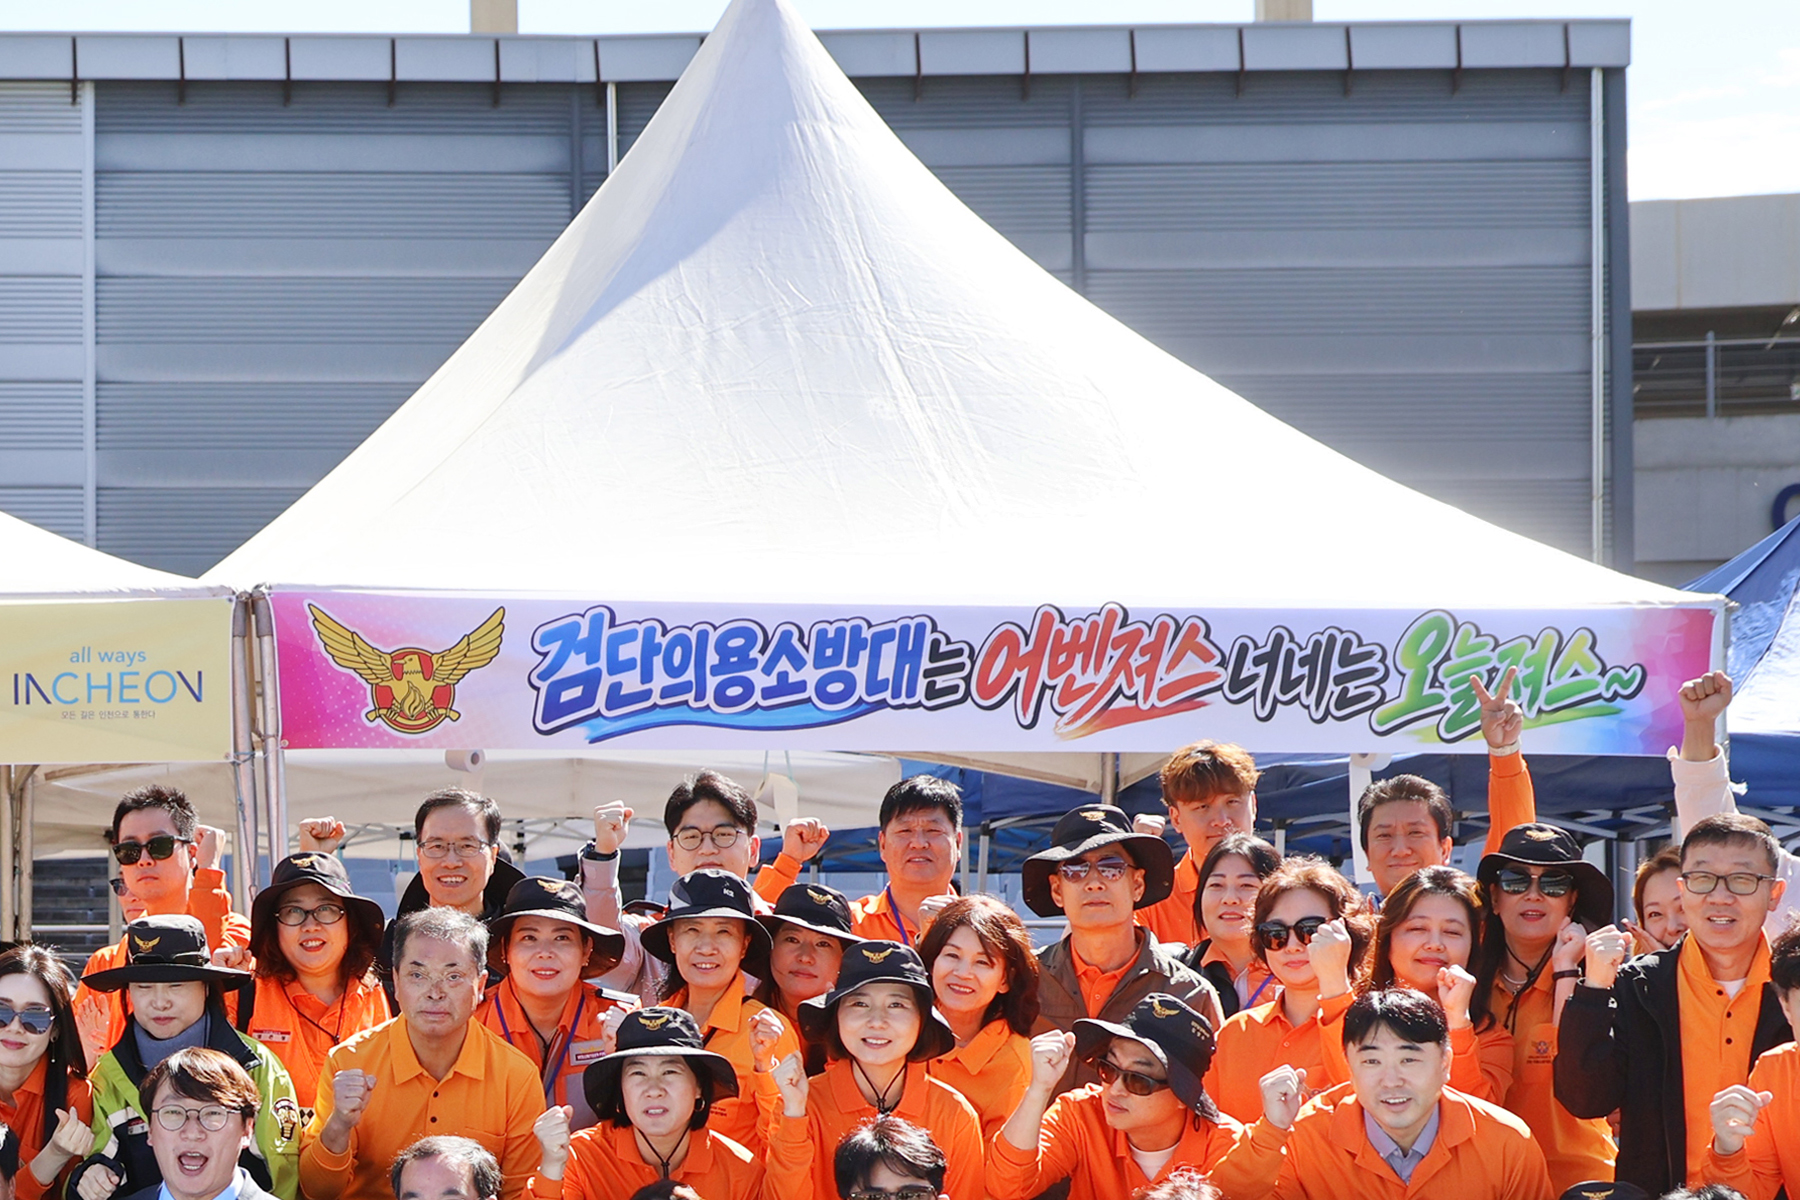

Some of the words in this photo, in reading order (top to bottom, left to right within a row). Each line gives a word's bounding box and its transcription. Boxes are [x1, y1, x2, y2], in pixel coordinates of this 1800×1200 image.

[69, 646, 91, 663] all
[98, 650, 147, 667] ways
[532, 608, 970, 730] 검단의용소방대는
[974, 605, 1224, 730] 어벤져스
[1228, 632, 1379, 717] 너네는
[13, 669, 203, 705] INCHEON
[61, 710, 76, 720] 모든
[80, 710, 95, 720] 길은
[99, 710, 129, 720] 인천으로
[133, 709, 156, 719] 통한다
[723, 888, 734, 897] K2
